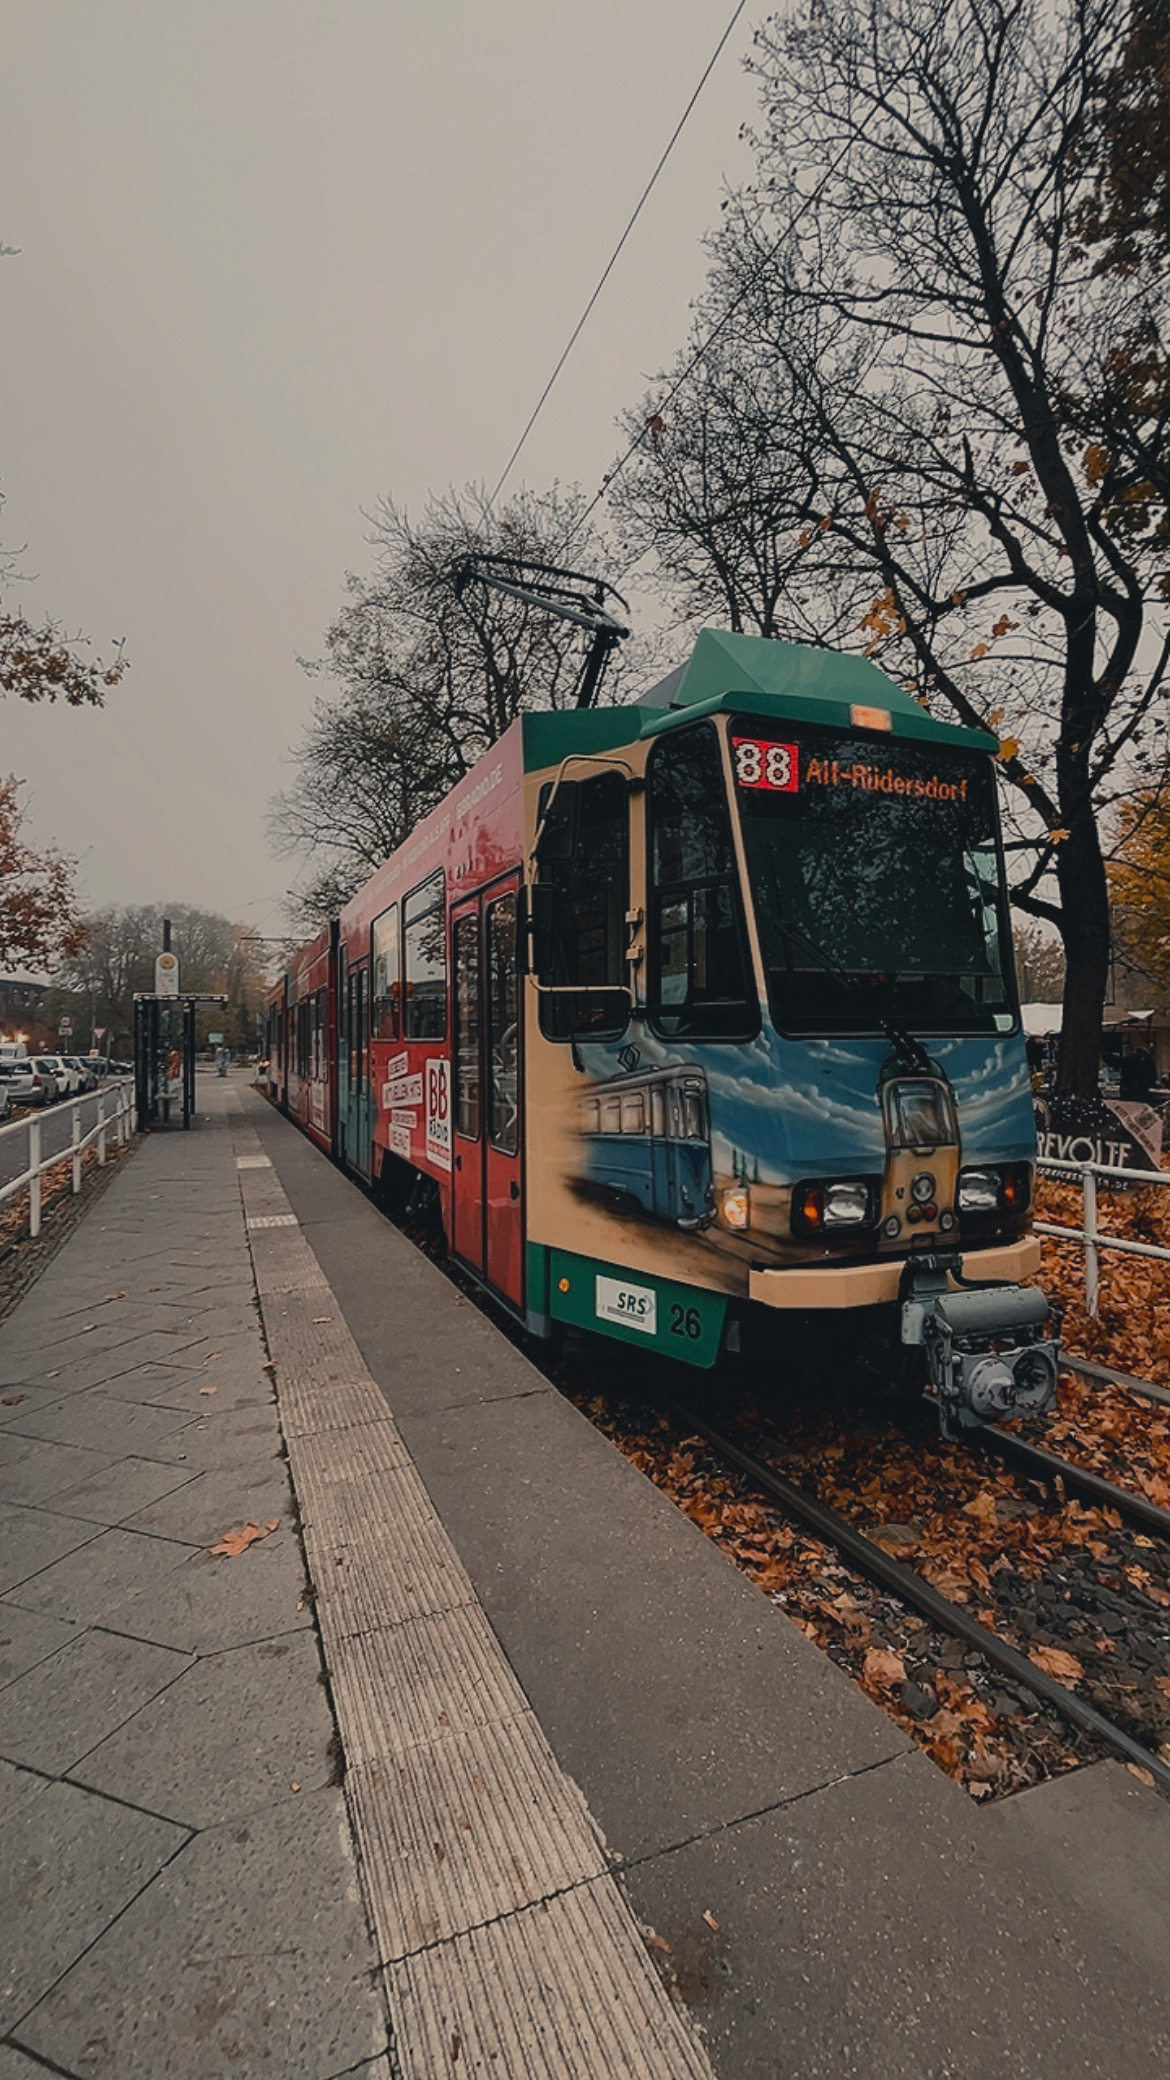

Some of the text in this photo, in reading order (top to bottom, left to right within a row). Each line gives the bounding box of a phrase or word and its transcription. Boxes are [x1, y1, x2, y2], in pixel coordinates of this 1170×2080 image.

[735, 743, 968, 802] 88 Alt-Rüdersdorf
[430, 1067, 447, 1120] BB
[617, 1292, 647, 1315] SRS
[670, 1303, 702, 1340] 26
